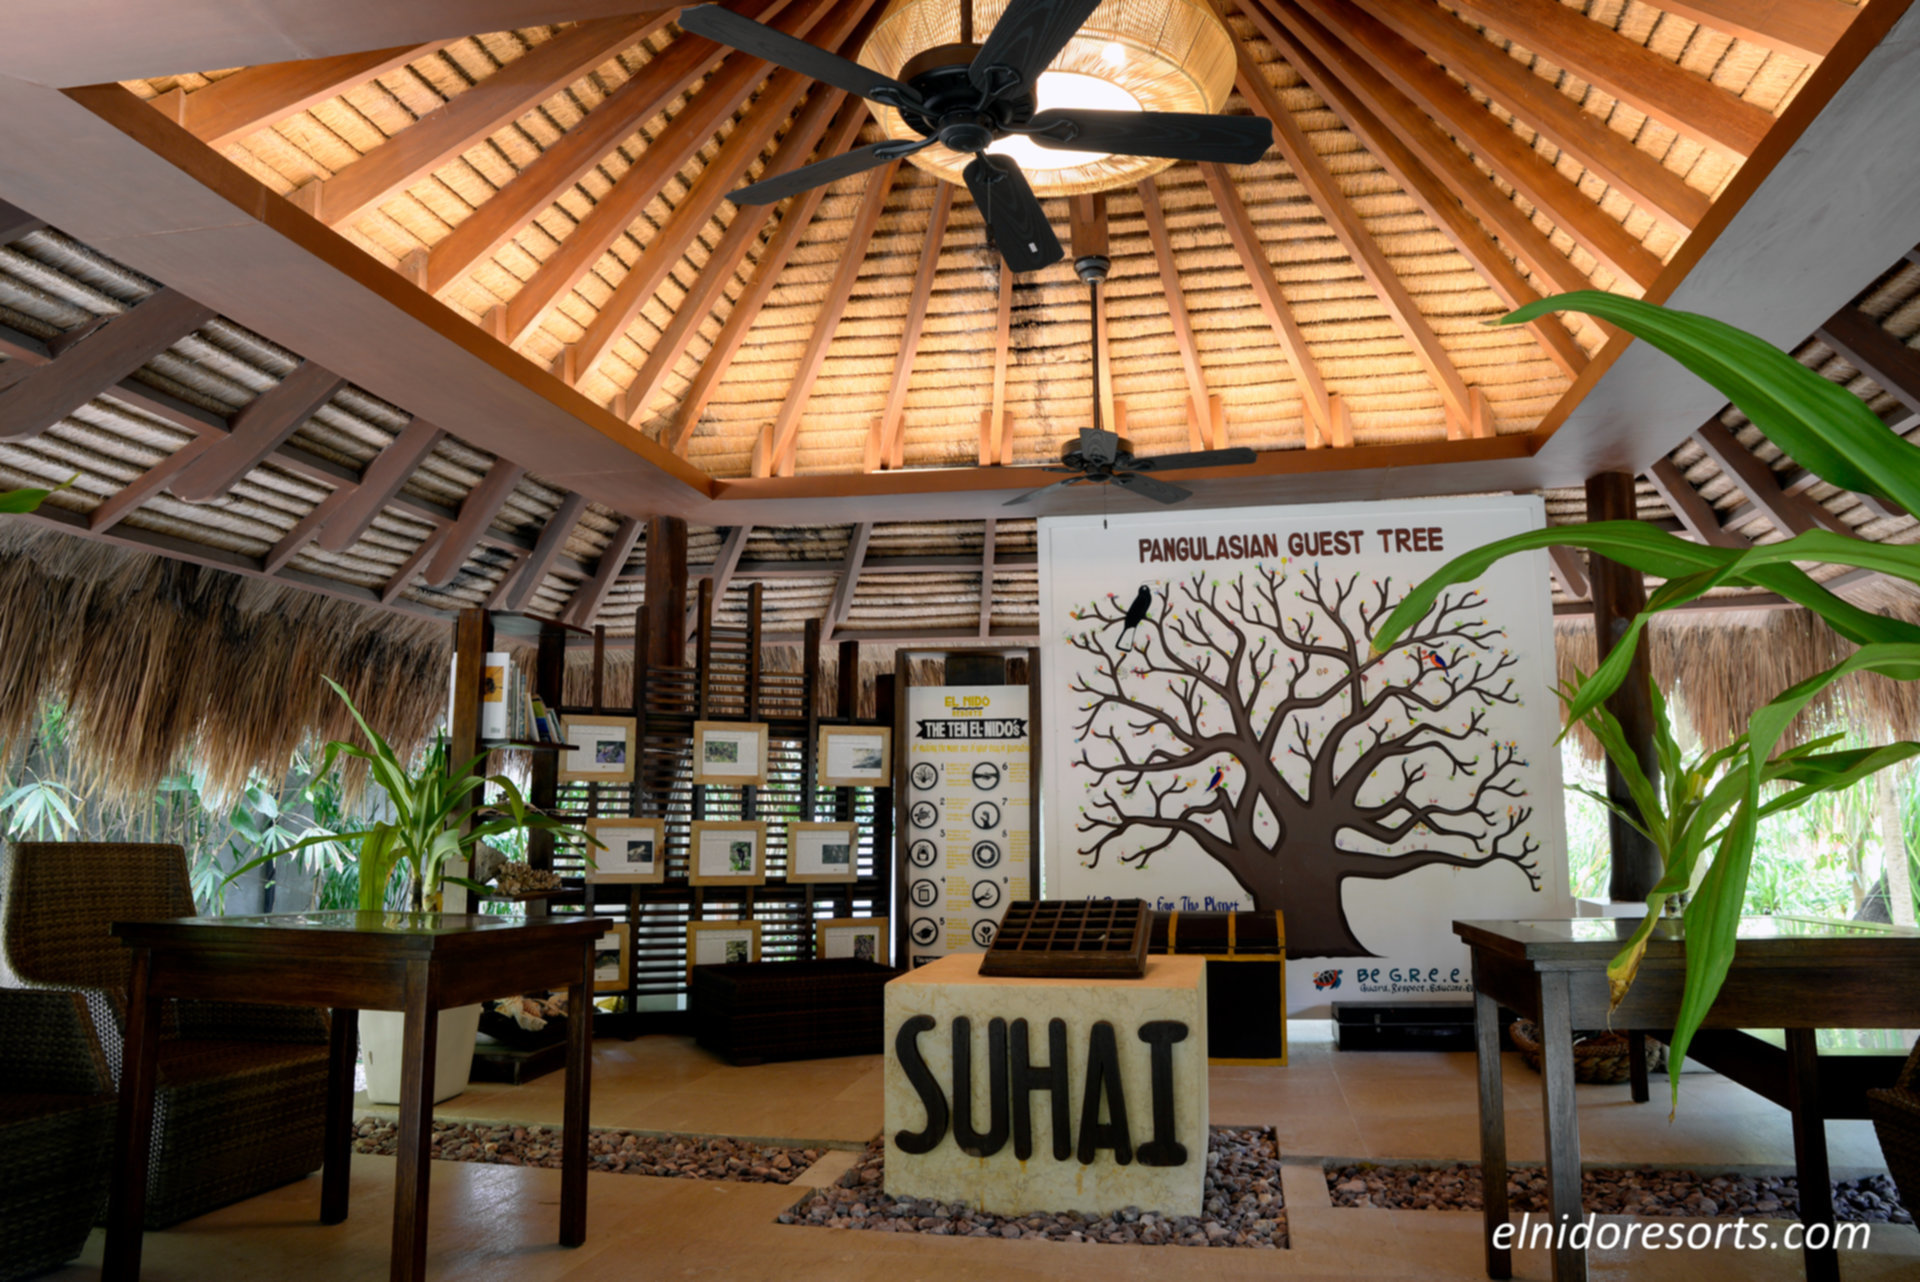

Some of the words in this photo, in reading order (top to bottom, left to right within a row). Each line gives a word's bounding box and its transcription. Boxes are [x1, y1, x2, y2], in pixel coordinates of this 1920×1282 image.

[1138, 533, 1279, 563] PANGULASIAN
[1287, 530, 1364, 557] GUEST
[1376, 527, 1444, 553] TREE
[944, 696, 959, 707] EL
[963, 696, 991, 707] NIDO
[925, 722, 946, 737] THE
[947, 722, 968, 737] TEN
[1002, 762, 1008, 771] 6
[1002, 797, 1008, 806] 7
[1180, 896, 1199, 910] The
[895, 1014, 1189, 1167] SUHAI
